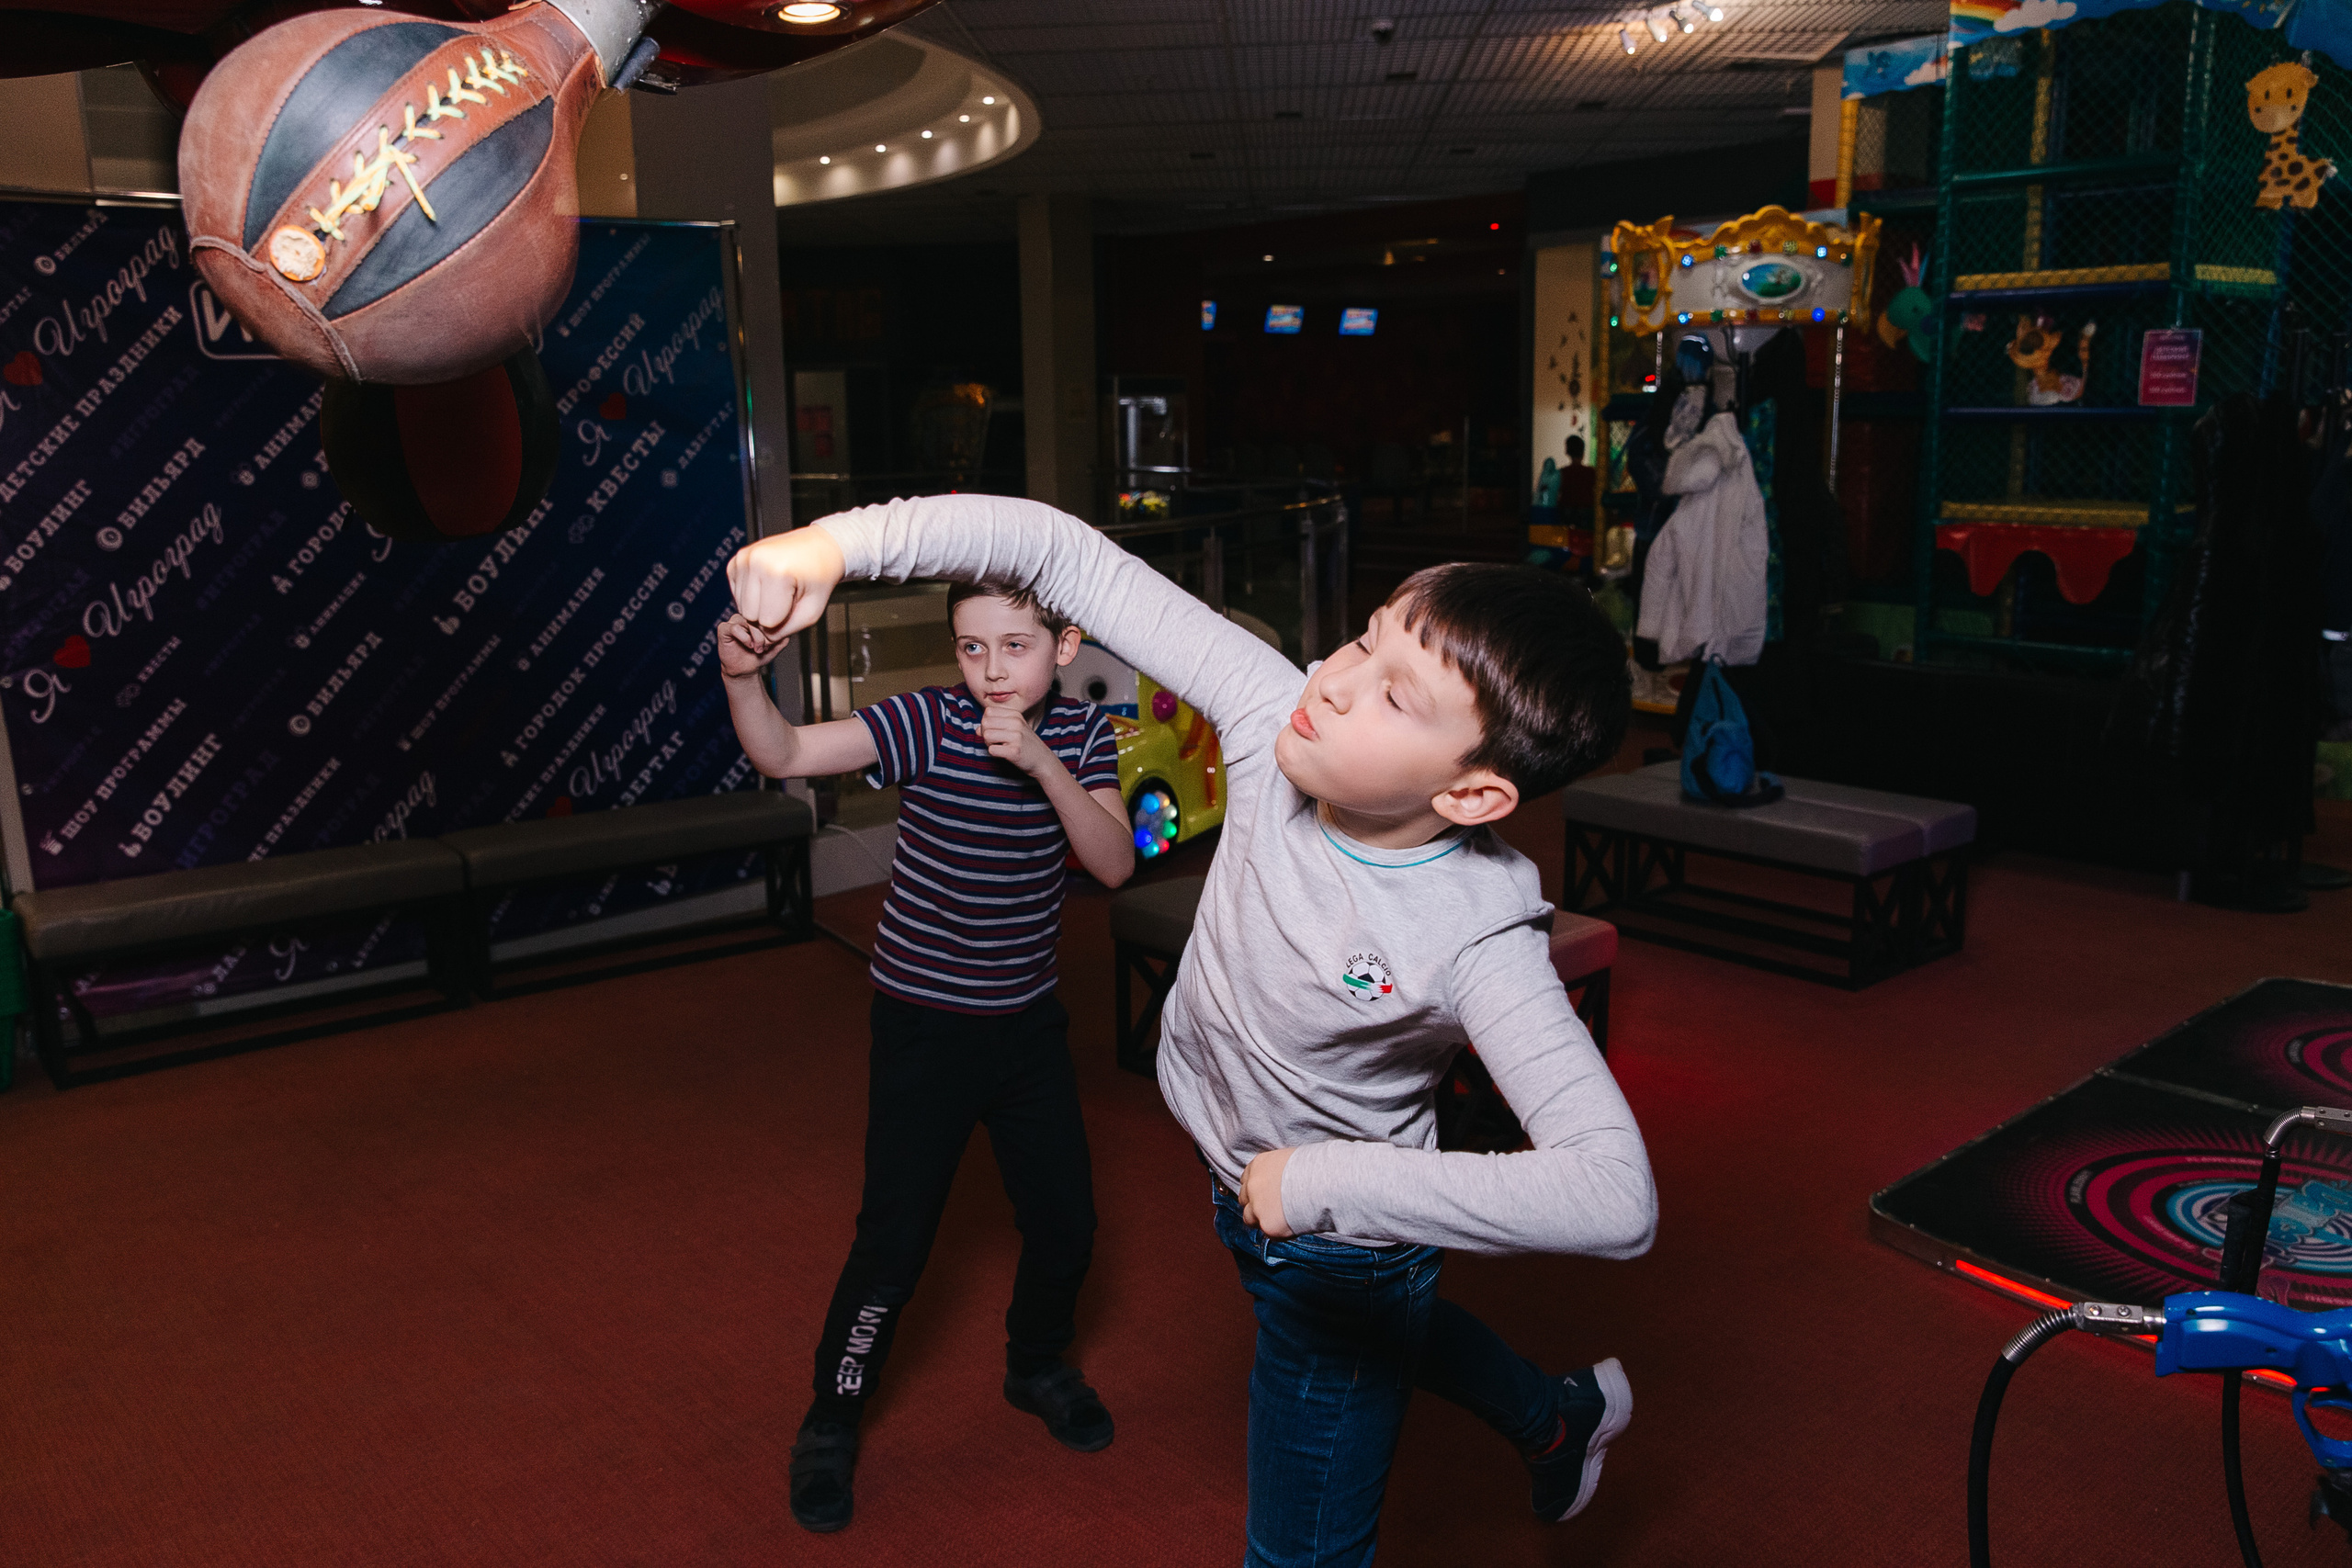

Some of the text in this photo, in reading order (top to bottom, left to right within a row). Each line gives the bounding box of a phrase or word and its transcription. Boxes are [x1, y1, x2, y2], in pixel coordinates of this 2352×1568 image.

[0, 305, 183, 503] ДЕТСКИЕ ПРАЗДНИКИ
[556, 312, 646, 415] ПРОФЕССИЙ
[117, 437, 206, 530] БИЛЬЯРД
[585, 421, 666, 513] КВЕСТЫ
[4, 479, 92, 573] БОУЛИНГ
[83, 502, 223, 637] Игроград
[680, 525, 746, 605] БИЛЬЯРД
[514, 666, 587, 750] ГОРОДОК
[582, 562, 670, 668] ПРОФЕССИЙ
[530, 567, 605, 657] АНИМАЦИЯ
[24, 669, 72, 723] Я
[137, 636, 181, 682] КВЕСТЫ
[306, 631, 383, 716] БИЛЬЯРД
[435, 634, 502, 711] ПРОГРАММЫ
[60, 799, 97, 840] ШОУ
[95, 698, 187, 801] ПРОГРАММЫ
[540, 704, 606, 783] ПРАЗДНИКИ
[569, 679, 677, 798] Игроград
[130, 733, 221, 842] БОУЛИНГ
[265, 757, 341, 844] ПРАЗДНИКИ
[1346, 953, 1391, 976] LEGA CALCIO
